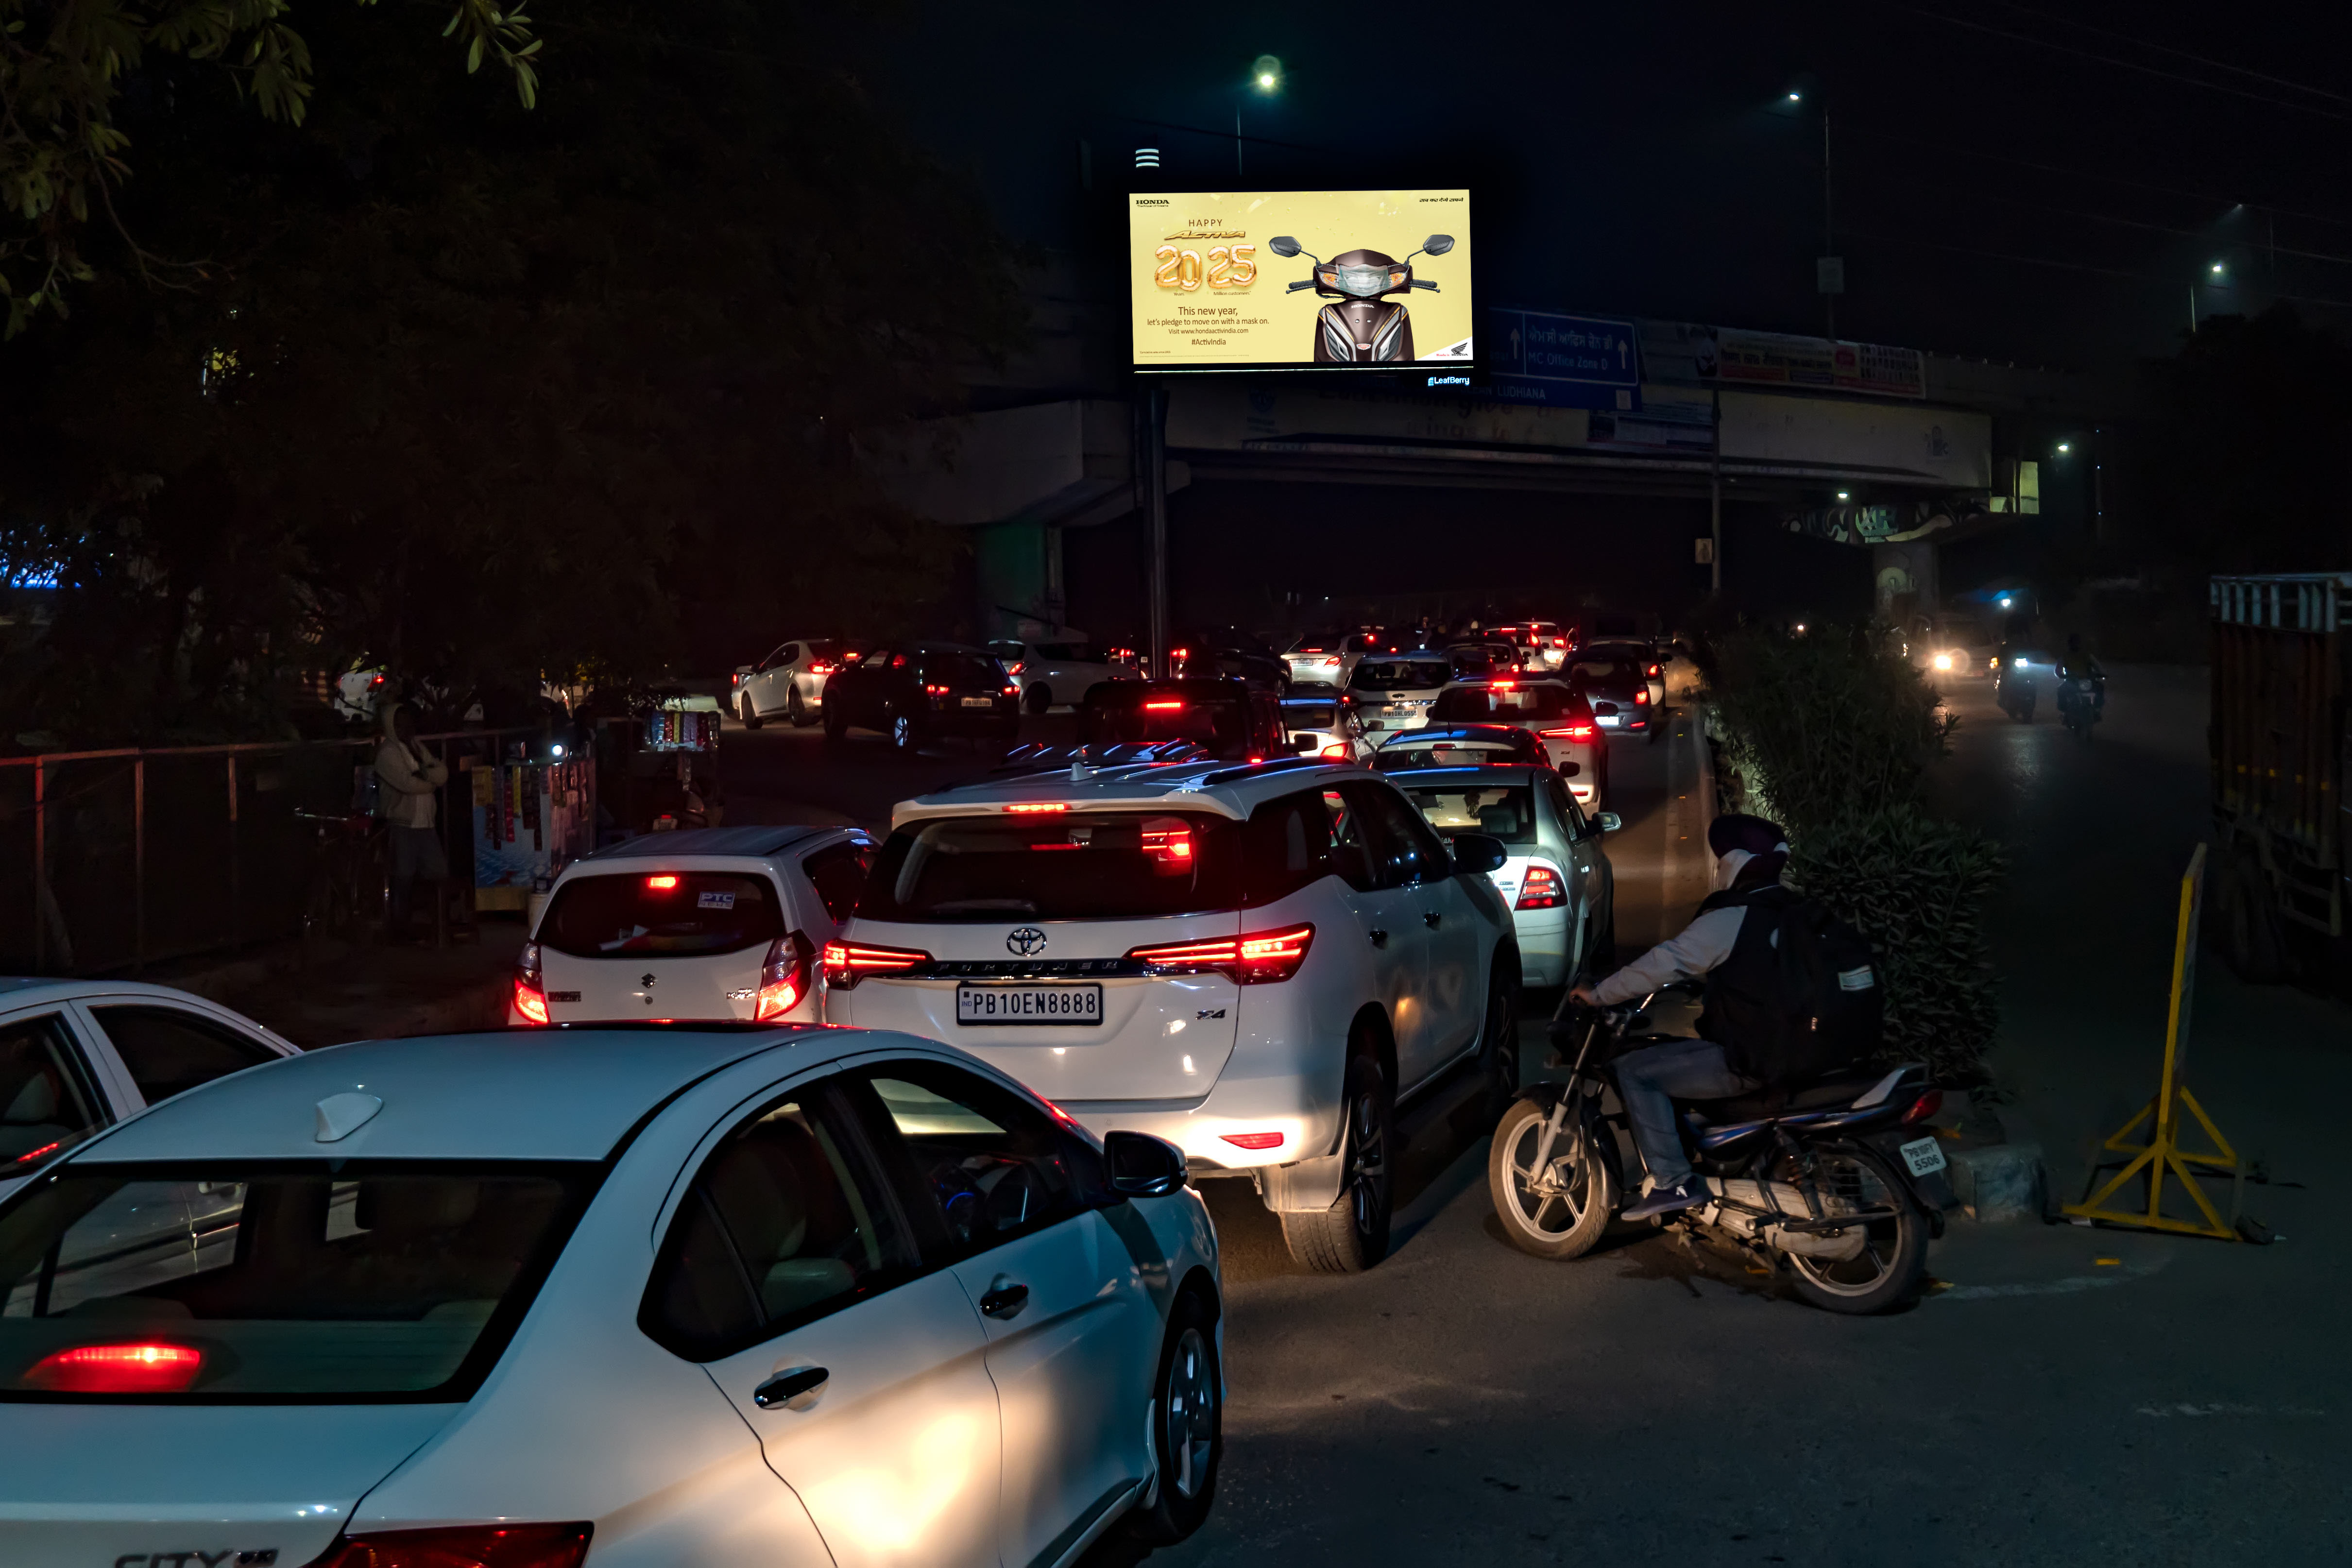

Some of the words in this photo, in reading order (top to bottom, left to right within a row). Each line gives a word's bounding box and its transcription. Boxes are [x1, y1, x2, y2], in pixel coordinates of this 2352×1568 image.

[1164, 230, 1245, 240] ACTIVA
[1177, 307, 1195, 315] This
[1218, 307, 1238, 317] year,
[1528, 352, 1544, 363] MC
[1547, 354, 1574, 367] Office
[1577, 356, 1598, 369] Zone
[1601, 358, 1608, 370] D
[1434, 376, 1470, 386] LeafBerry
[1498, 384, 1546, 400] LUDHIANA
[700, 893, 733, 902] PTC
[974, 993, 1095, 1014] PB10EN8888
[115, 1549, 234, 1568] CITY
